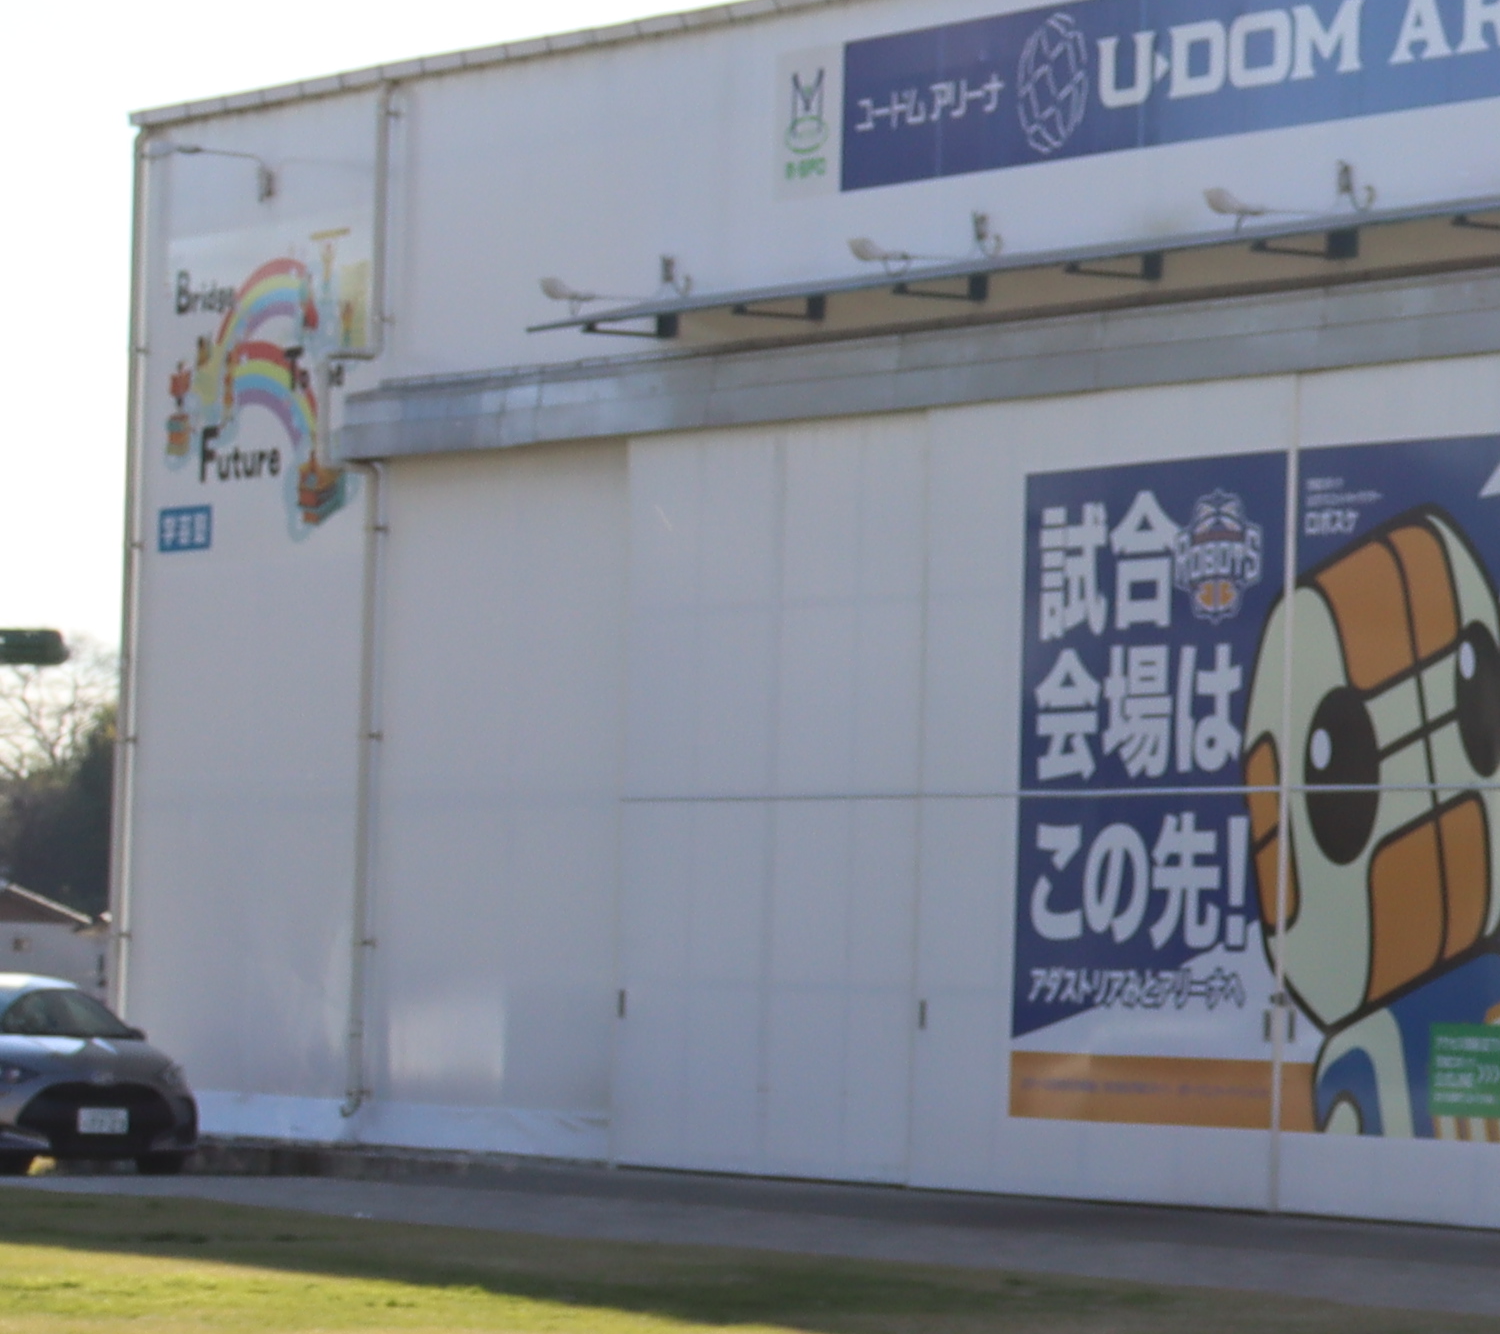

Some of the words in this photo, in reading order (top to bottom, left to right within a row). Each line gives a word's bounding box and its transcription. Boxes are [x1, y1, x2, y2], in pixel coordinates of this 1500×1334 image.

[199, 426, 281, 484] Future
[1038, 489, 1182, 643] 試合
[1034, 642, 1242, 783] 会場は
